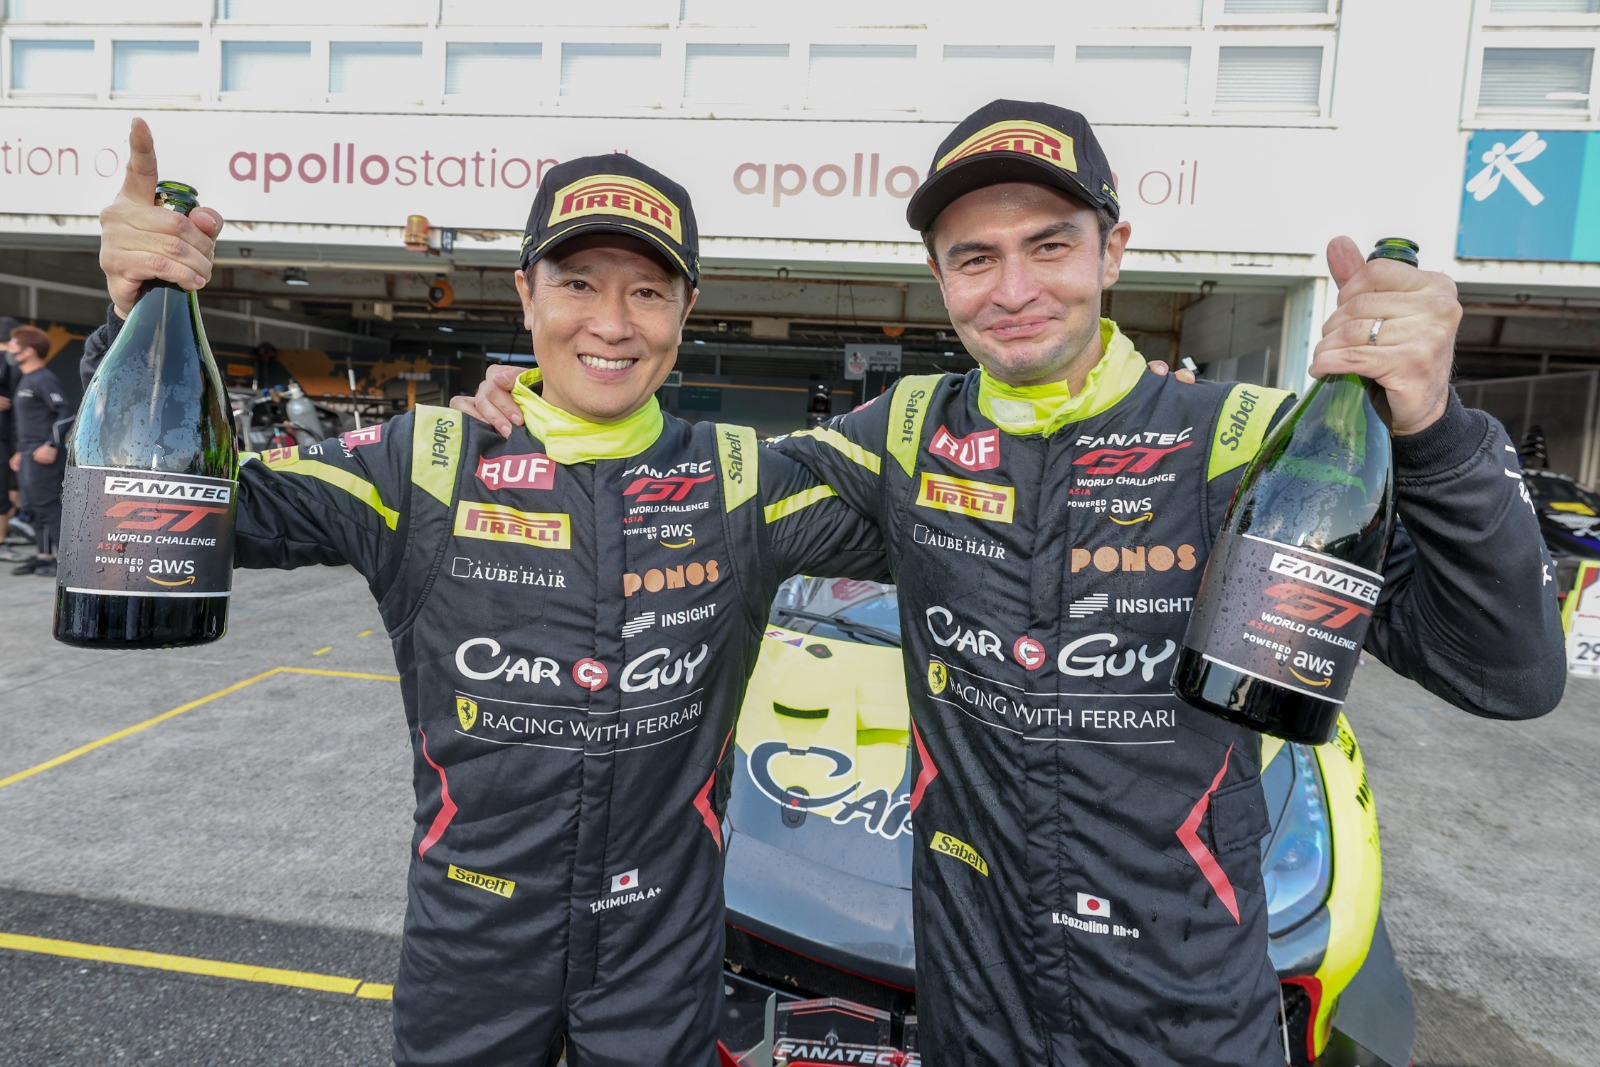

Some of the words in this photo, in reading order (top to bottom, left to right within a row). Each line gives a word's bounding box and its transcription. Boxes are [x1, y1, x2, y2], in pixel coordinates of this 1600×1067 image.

[944, 128, 1062, 167] PELLI
[1138, 160, 1198, 206] oil
[559, 182, 673, 230] PIRELLI
[901, 389, 926, 444] Sabelt
[1220, 389, 1260, 452] Sabelt
[432, 417, 455, 469] Sabelt
[936, 429, 995, 465] RUF
[1075, 427, 1193, 448] FANATEC
[480, 457, 549, 485] RUF
[621, 460, 712, 479] FANATEC
[727, 431, 742, 485] Sabelt
[109, 480, 228, 500] FANATEC
[1068, 488, 1092, 496] ASIA
[1076, 478, 1114, 487] WORLD
[1115, 473, 1177, 487] CHALLENGE
[629, 505, 660, 515] WORLD
[660, 501, 710, 513] CHALLENGE
[926, 480, 1008, 516] PIRELLI
[1067, 499, 1107, 508] POWERED
[1111, 497, 1152, 514] aws
[465, 508, 562, 542] PIRELLI
[623, 515, 644, 524] ASIA
[623, 526, 657, 536] POWERED
[660, 523, 693, 538] aws
[97, 543, 124, 551] ASIA
[107, 532, 153, 544] WORLD
[155, 535, 217, 547] CHALLENGE
[927, 533, 963, 552] AUBE
[965, 540, 1006, 560] HAIR
[95, 556, 144, 565] POWERED
[149, 557, 195, 575] aws
[129, 565, 143, 573] BY
[1071, 544, 1197, 573] PONOS
[472, 566, 519, 583] AUBE
[521, 571, 567, 588] HAIR
[623, 559, 720, 597] PONOS
[1276, 558, 1380, 602] FANATEC
[661, 603, 717, 628] INSIGHT
[1115, 597, 1194, 614] INSIGHT
[1248, 619, 1277, 634] ASIA
[1261, 611, 1306, 633] WORLD
[1307, 627, 1357, 651] CHALLENGE
[925, 605, 1005, 662] CAR
[1057, 632, 1177, 682] GUY
[1243, 632, 1292, 655] POWERED
[1293, 649, 1336, 677] aws
[455, 637, 561, 686] CAR
[619, 644, 708, 693] GUY
[1275, 652, 1289, 663] BY
[950, 675, 1008, 715] RACING
[1011, 699, 1073, 727] WITH
[1081, 708, 1175, 730] FERRARI
[482, 711, 564, 737] RACING
[569, 719, 629, 743] WITH
[636, 701, 703, 736] FERRARI
[937, 836, 985, 873] Sabelt
[455, 868, 508, 895] Sabelt
[590, 890, 645, 914] T.KIMURA
[647, 887, 661, 899] A+
[1052, 912, 1109, 935] K.Cozzolino
[776, 1043, 894, 1066] FANATEC
